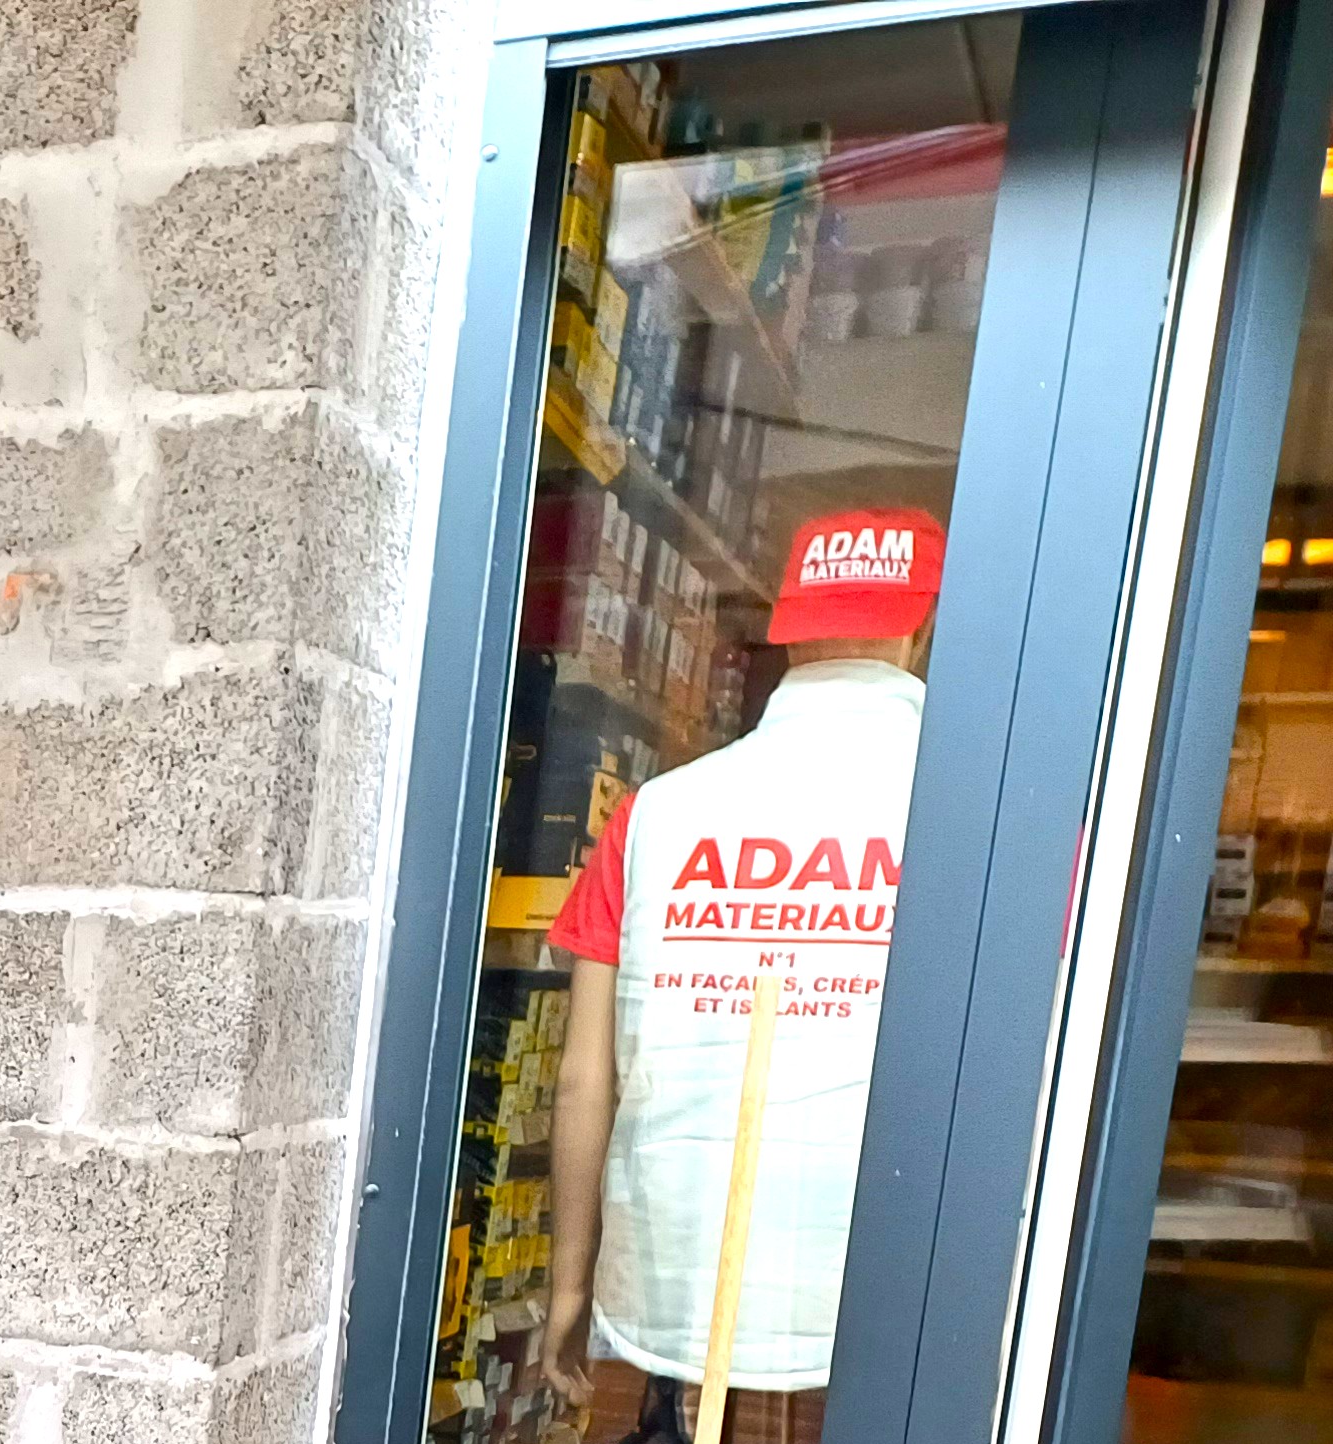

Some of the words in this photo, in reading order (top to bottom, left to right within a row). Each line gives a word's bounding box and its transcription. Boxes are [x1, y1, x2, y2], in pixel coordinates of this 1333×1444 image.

[802, 528, 913, 564] ADAM
[799, 559, 912, 581] MATERIAUX
[672, 837, 903, 891] ADAM
[664, 901, 896, 932] MATERIAU
[654, 973, 682, 988] EN
[691, 974, 804, 996] FAÇAS,
[694, 998, 723, 1013] ET
[731, 999, 852, 1018] ISANTS
